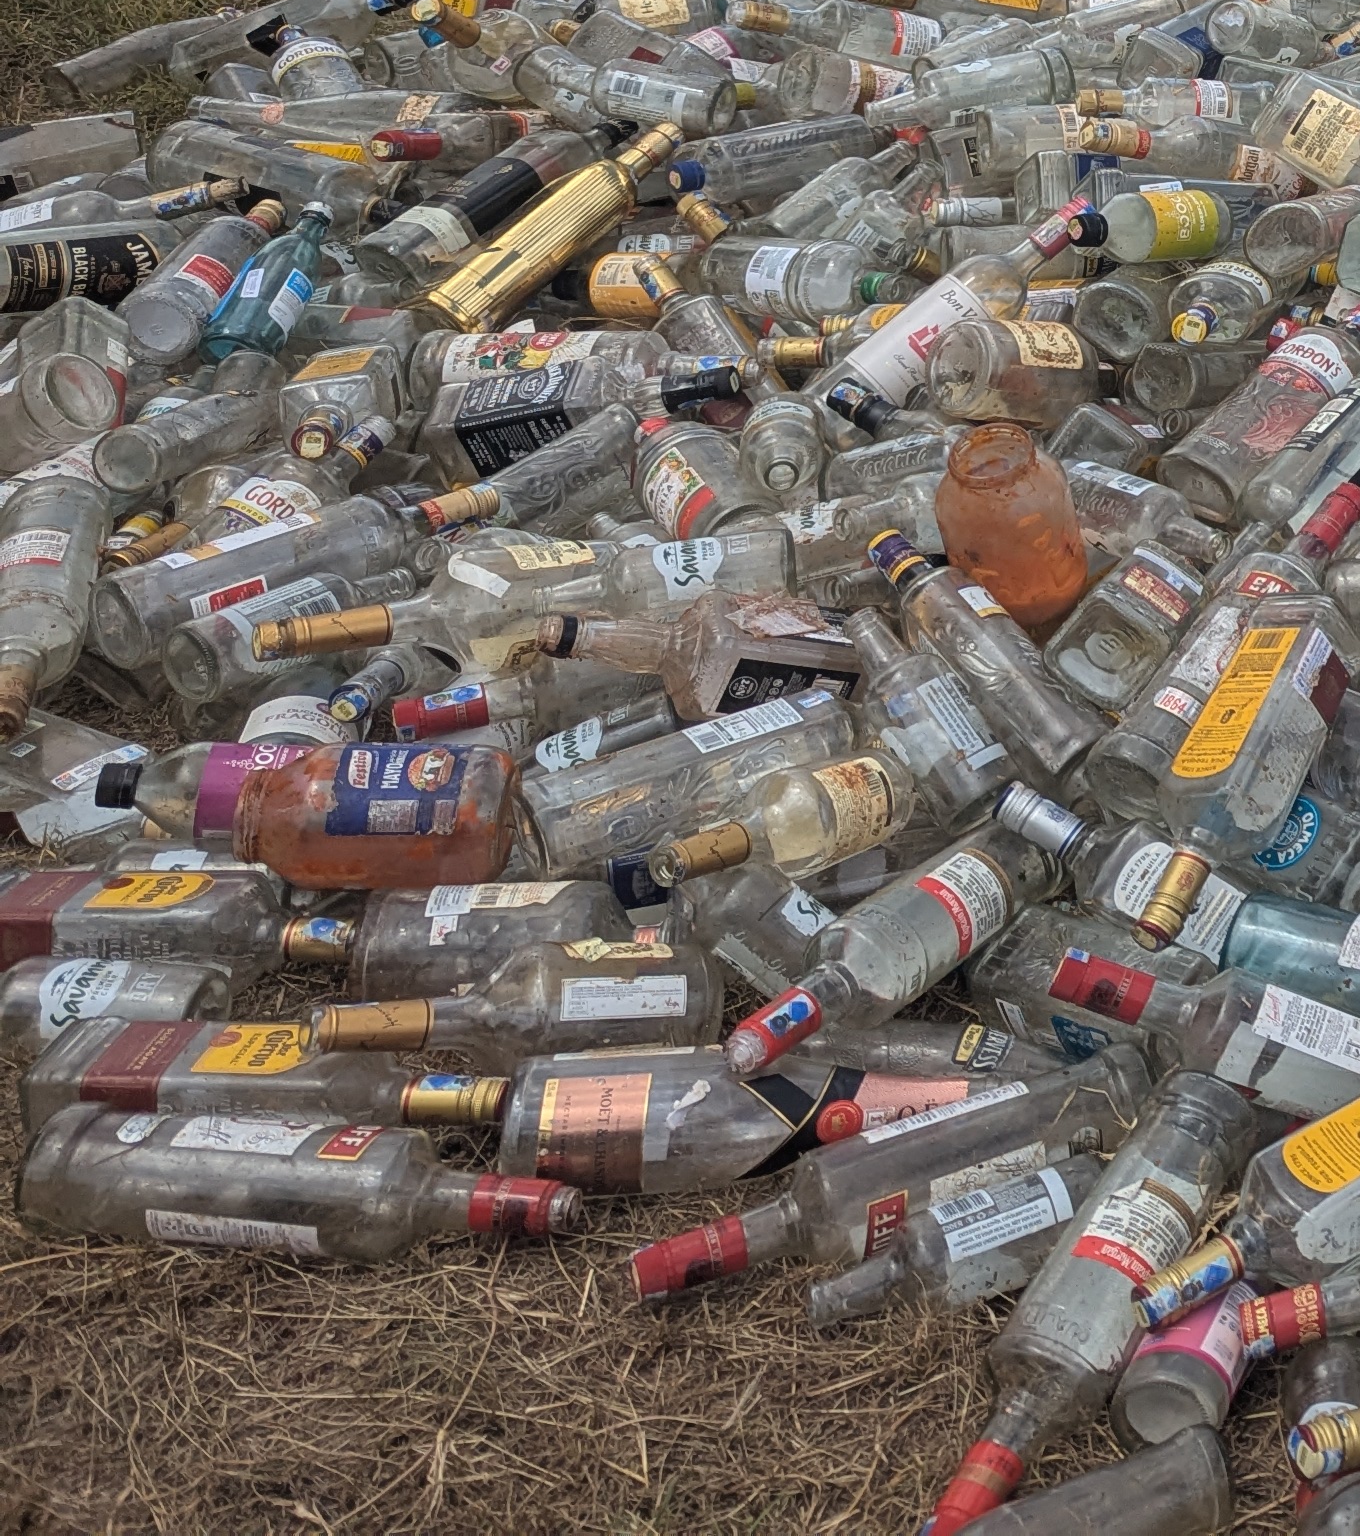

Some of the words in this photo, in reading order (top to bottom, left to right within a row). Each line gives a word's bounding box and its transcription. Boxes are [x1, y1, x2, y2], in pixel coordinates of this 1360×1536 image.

[940, 288, 965, 314] Bon
[1272, 343, 1342, 379] GORDON'S
[1160, 693, 1189, 715] 1864
[1277, 811, 1315, 864] OLMECA
[247, 1029, 295, 1068] Cuervo
